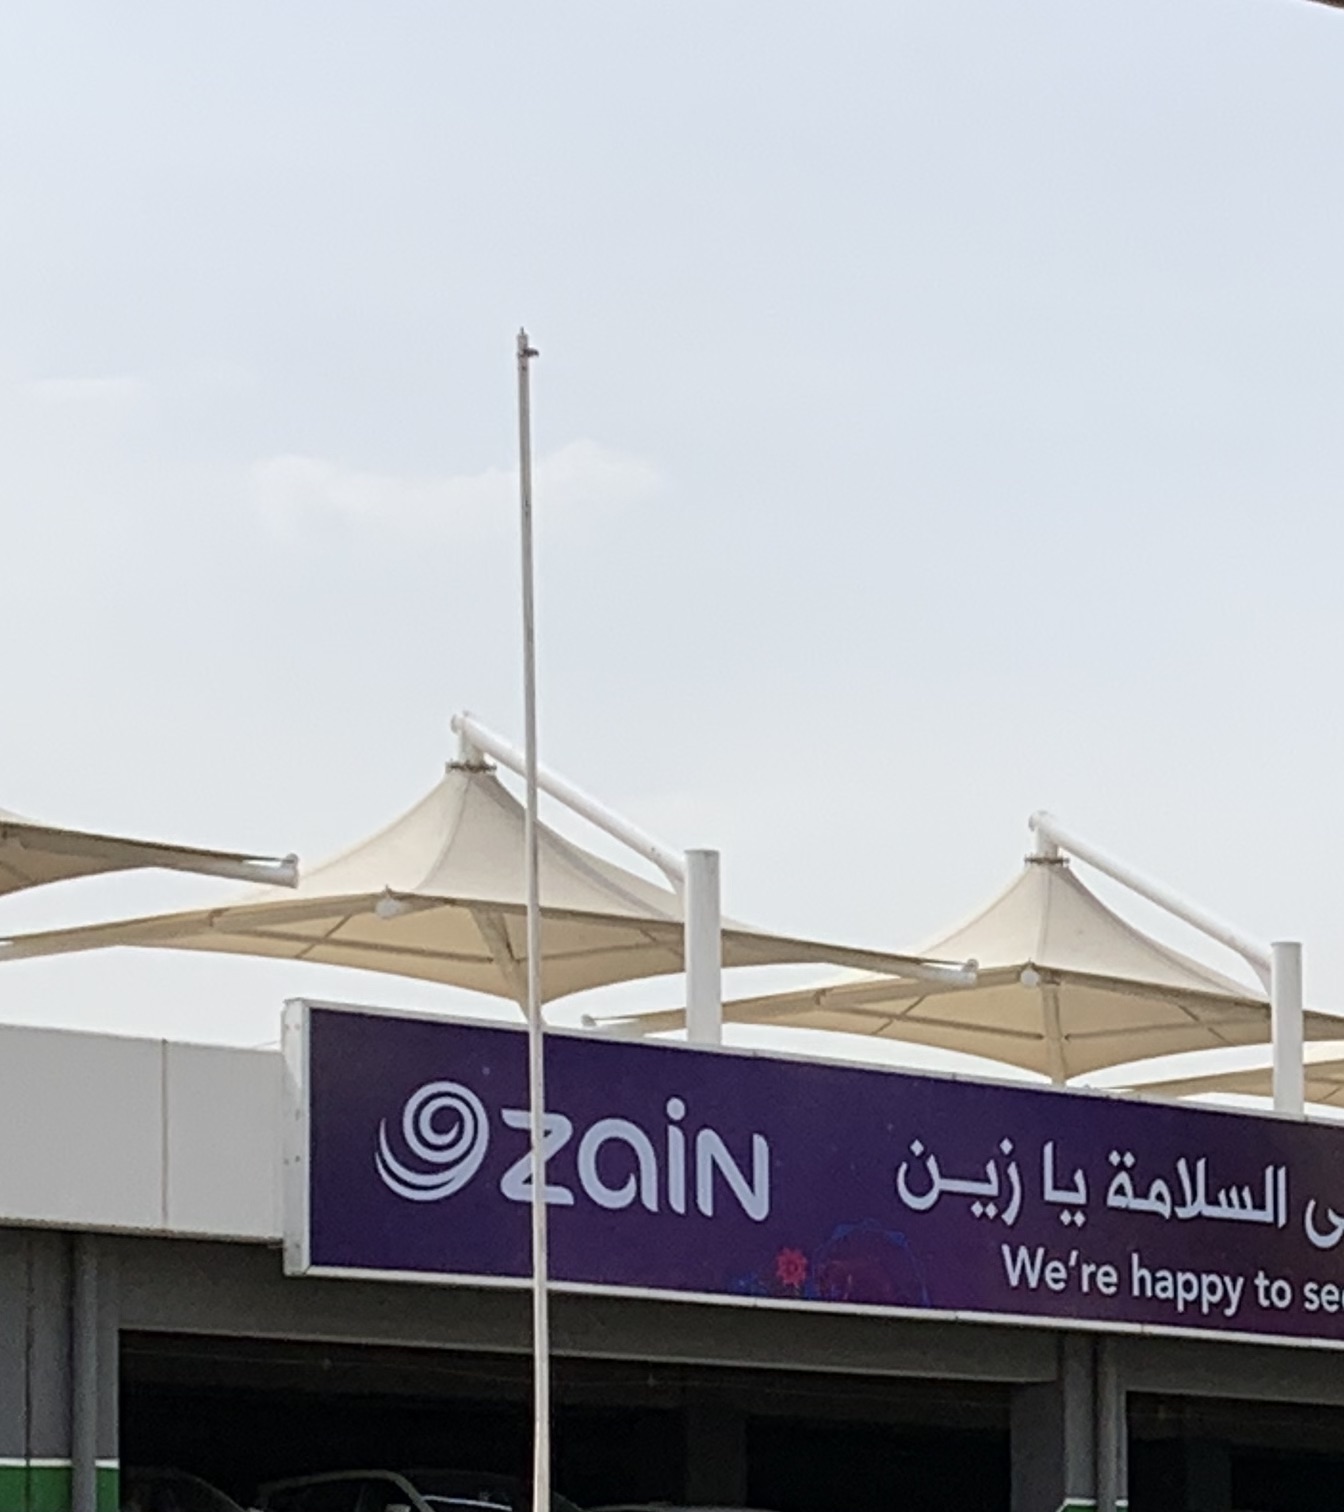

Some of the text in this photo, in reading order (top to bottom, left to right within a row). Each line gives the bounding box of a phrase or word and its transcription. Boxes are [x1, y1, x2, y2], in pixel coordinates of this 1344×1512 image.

[896, 1137, 1023, 1226] زين
[1042, 1140, 1088, 1228] يا
[1106, 1149, 1288, 1229] السلامة
[1001, 1243, 1119, 1295] We're
[1131, 1251, 1245, 1318] happy
[1253, 1269, 1293, 1309] to
